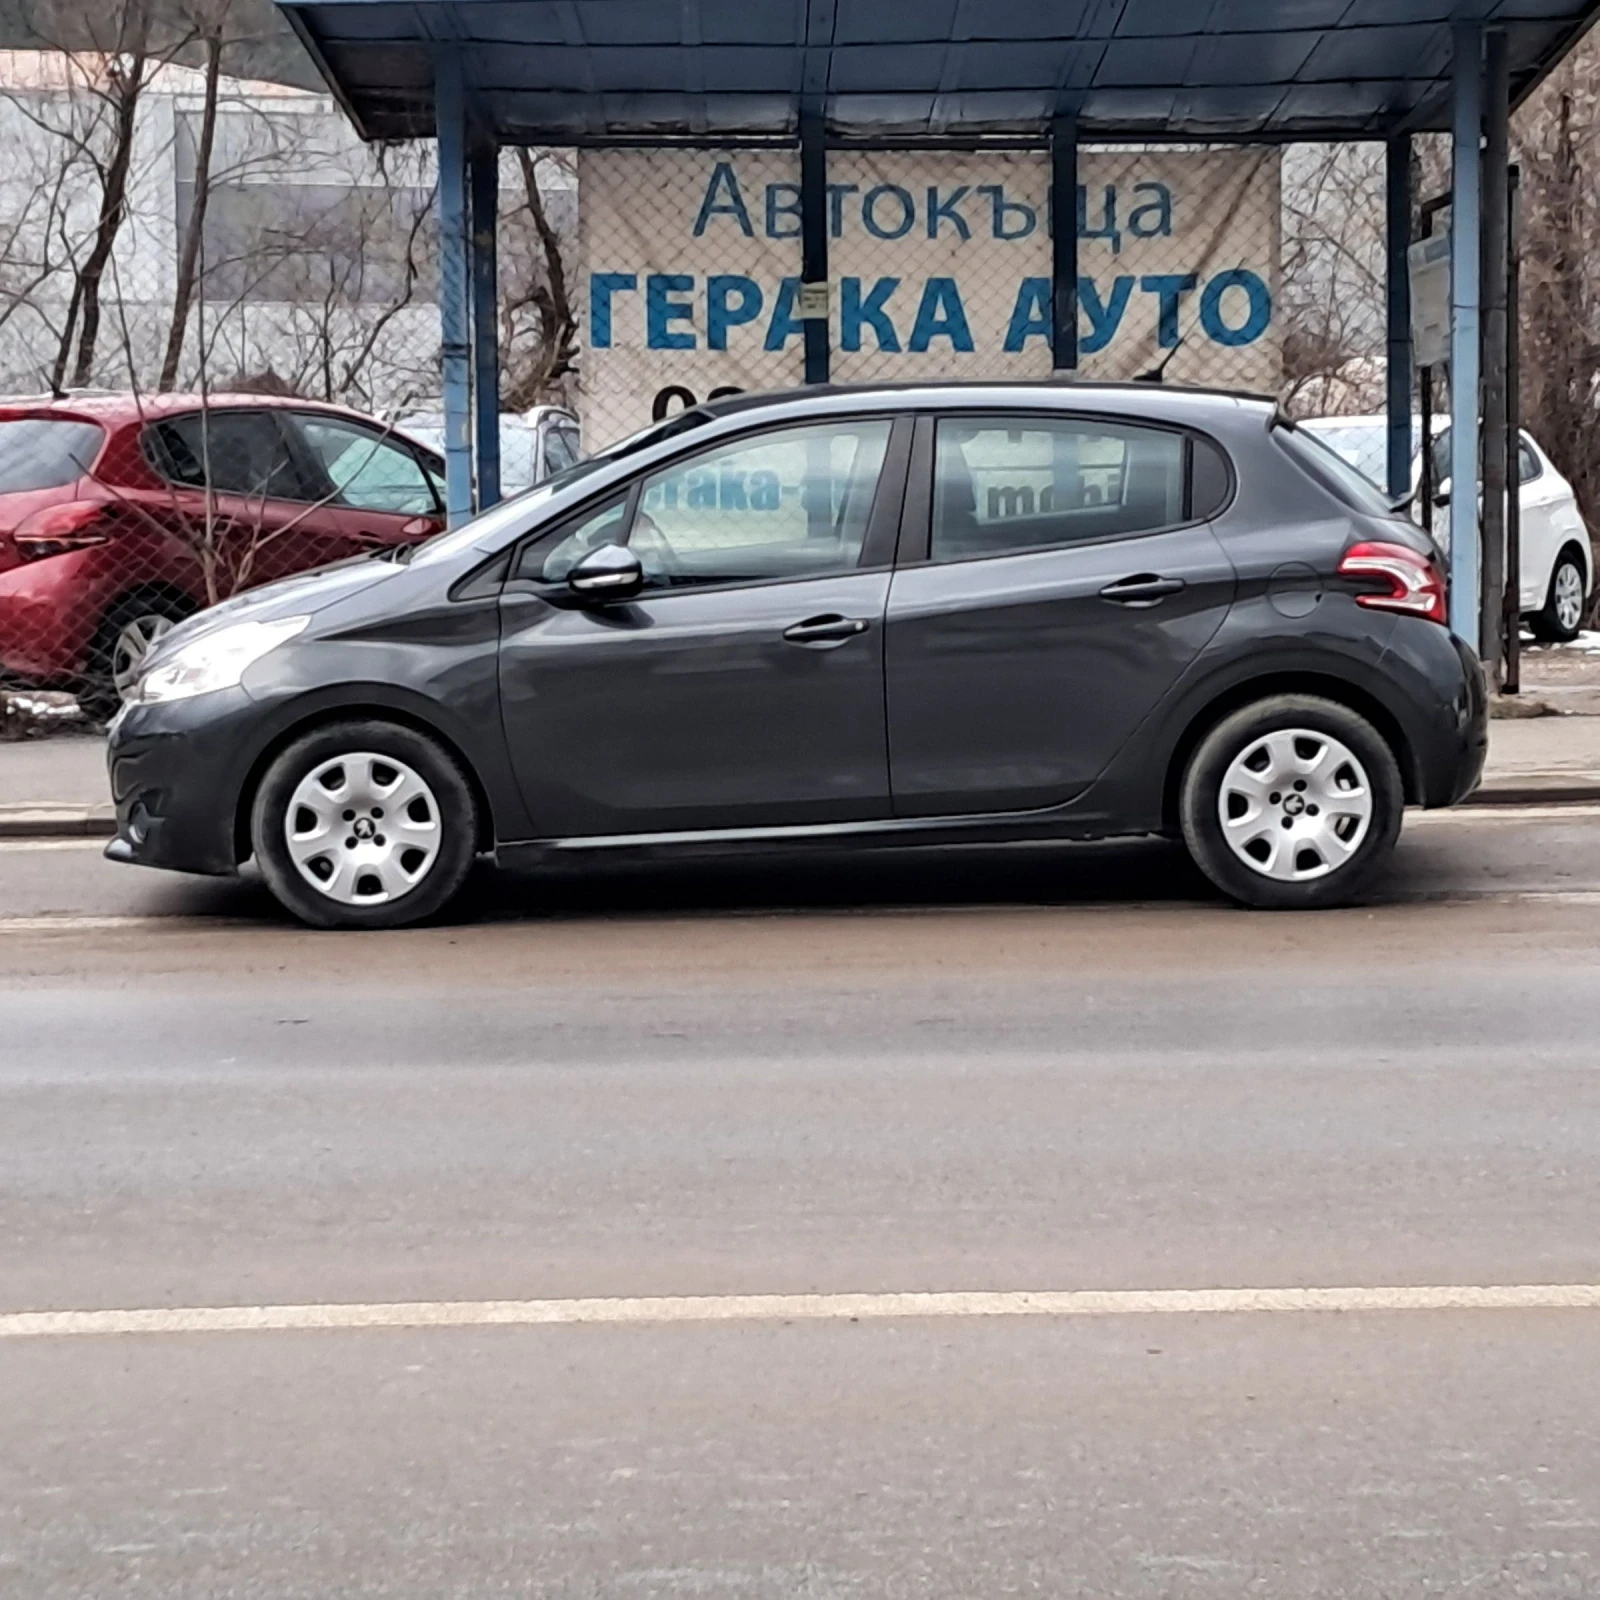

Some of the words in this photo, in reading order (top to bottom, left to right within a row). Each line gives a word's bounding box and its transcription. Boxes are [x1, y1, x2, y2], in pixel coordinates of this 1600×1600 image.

[692, 162, 1171, 254] Автокъща
[590, 272, 975, 352] ГЕРАКА
[1003, 268, 1271, 353] АУТО
